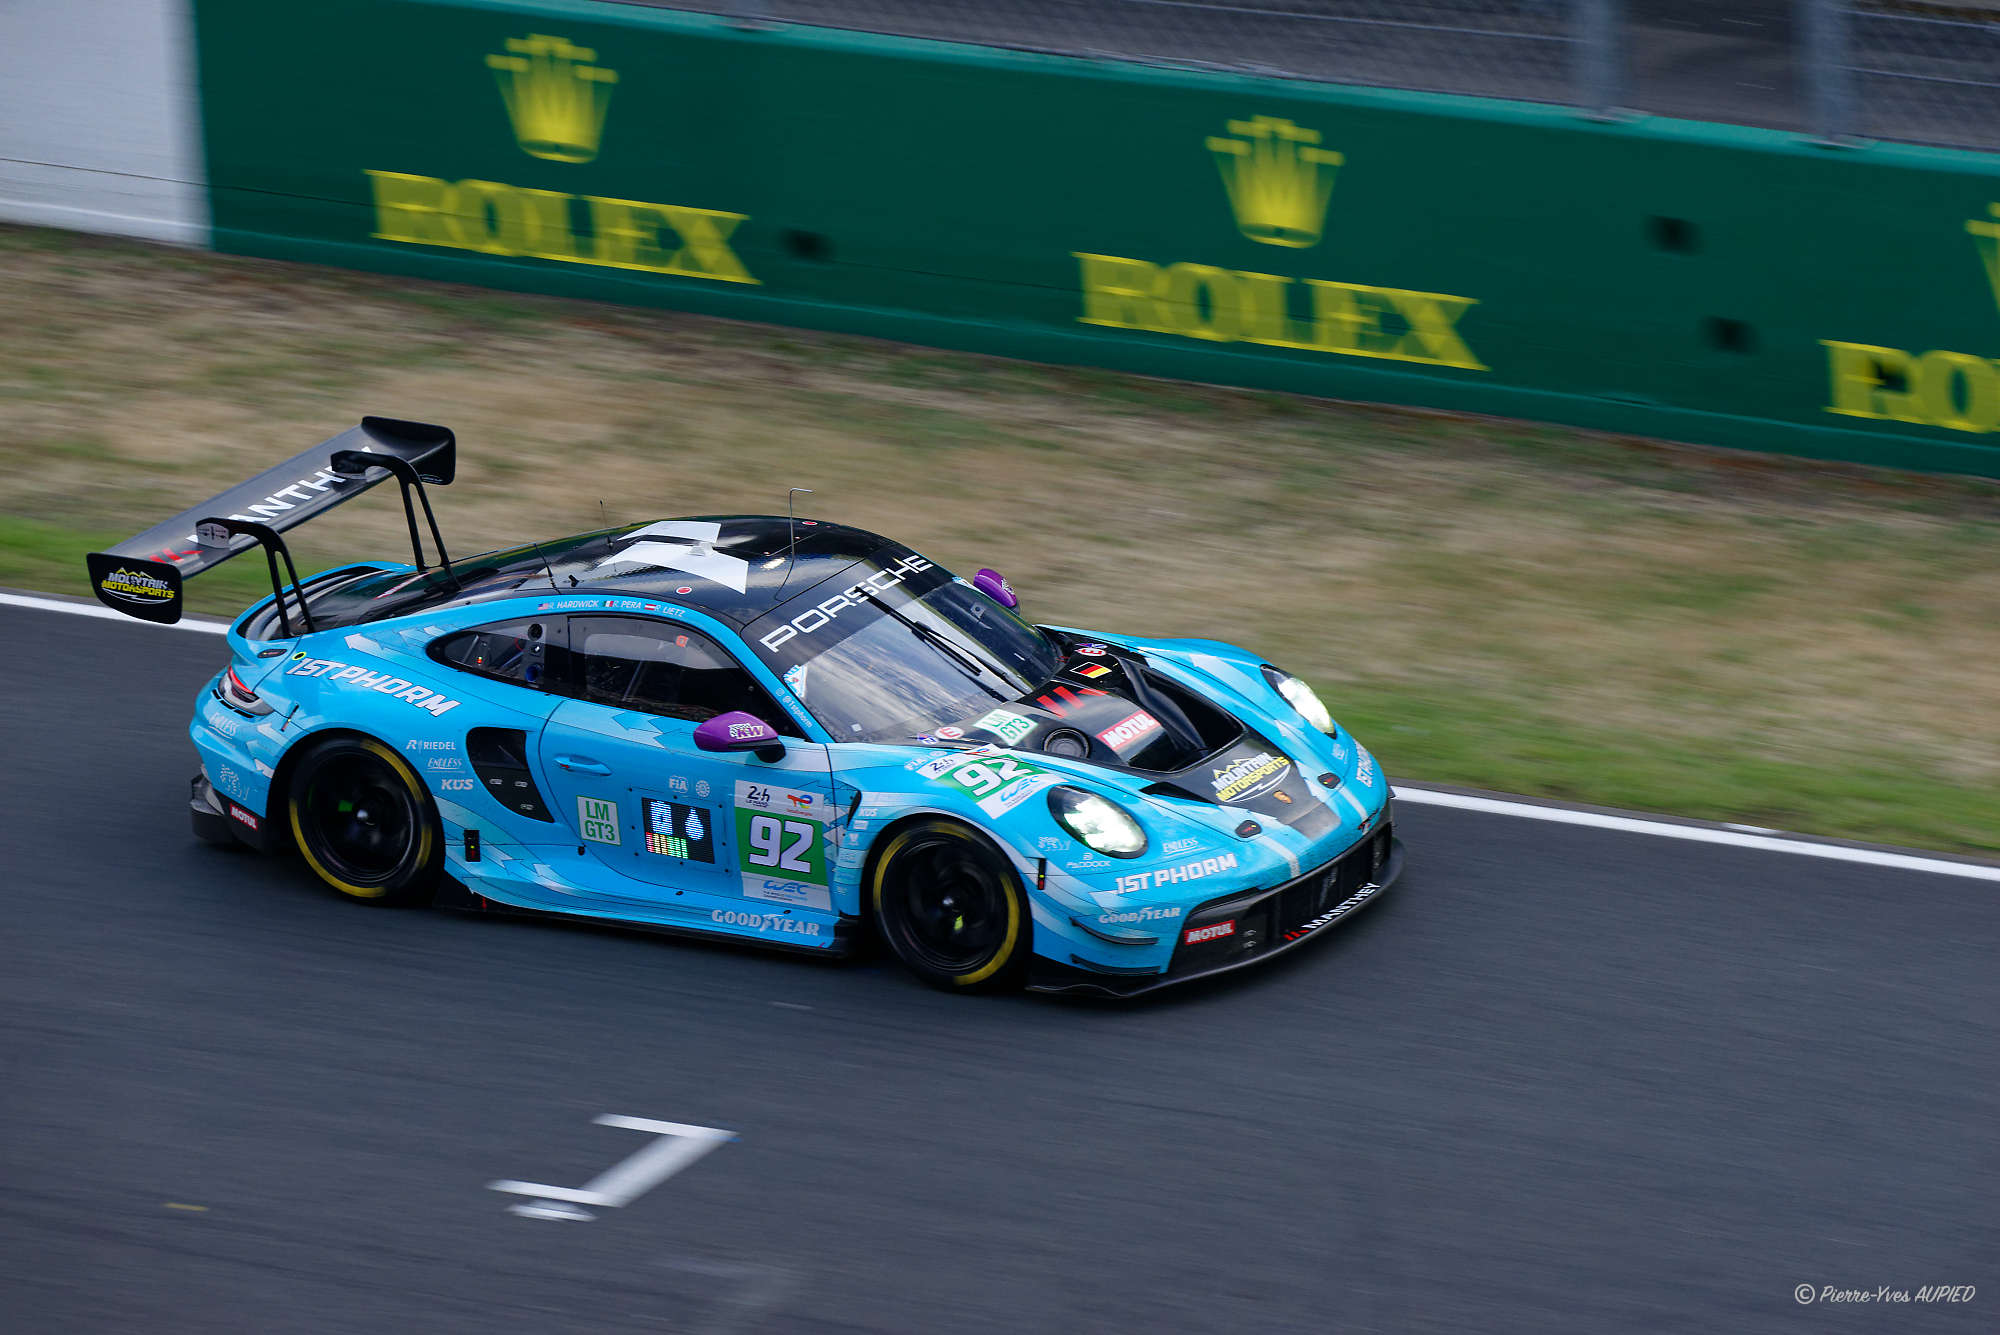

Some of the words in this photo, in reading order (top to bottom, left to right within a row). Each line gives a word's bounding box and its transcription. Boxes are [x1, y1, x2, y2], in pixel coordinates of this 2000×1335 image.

[364, 170, 761, 285] ROLEX
[1072, 252, 1491, 371] ROLEX
[1816, 338, 2000, 433] RO
[101, 580, 175, 599] MOTORSPORTS
[759, 555, 934, 653] PORSCHE
[557, 600, 599, 609] HARDWICK
[621, 600, 641, 609] PERA
[663, 606, 686, 618] LIETZ
[328, 665, 462, 717] PHORM
[424, 741, 456, 750] RIEDEL
[1102, 713, 1156, 748] MOTUL
[669, 777, 688, 791] FIA
[952, 757, 1033, 797] 92
[1211, 752, 1275, 791] MOUNTAIN
[1215, 756, 1290, 801] MOTORSPORTS
[585, 800, 609, 821] LM
[584, 820, 615, 841] GT3
[749, 814, 814, 875] 92
[1154, 853, 1238, 887] PHORM
[712, 909, 820, 936] GOODYEAR
[1099, 906, 1181, 924] GOODYEAR
[1301, 882, 1381, 929] MANTHEY
[1187, 922, 1233, 943] MOTUL
